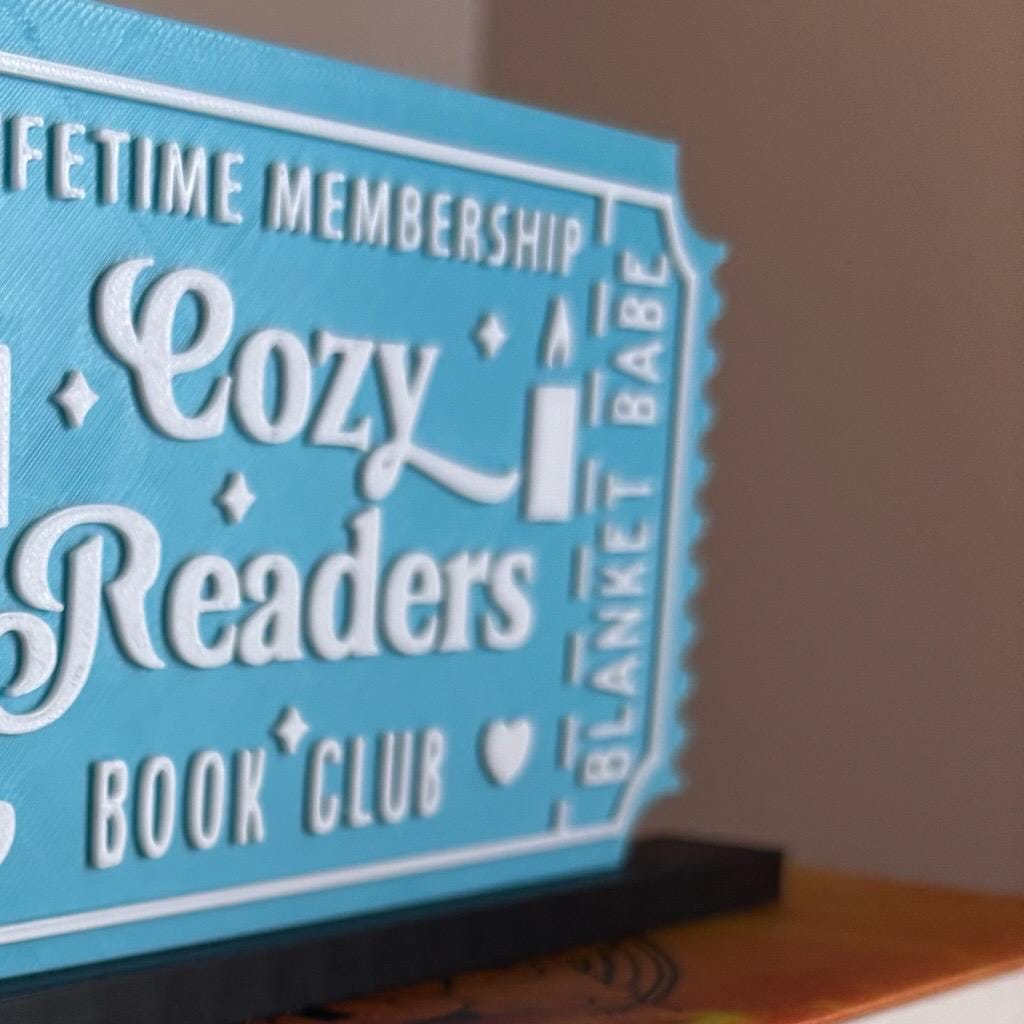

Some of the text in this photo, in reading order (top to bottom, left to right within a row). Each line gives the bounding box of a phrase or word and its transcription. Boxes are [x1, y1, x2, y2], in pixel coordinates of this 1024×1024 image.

[267, 159, 583, 277] MEMBERSHIP
[94, 257, 519, 504] Cozy
[579, 248, 670, 788] BLANKET BABE
[89, 726, 446, 870] BOOK CLUB
